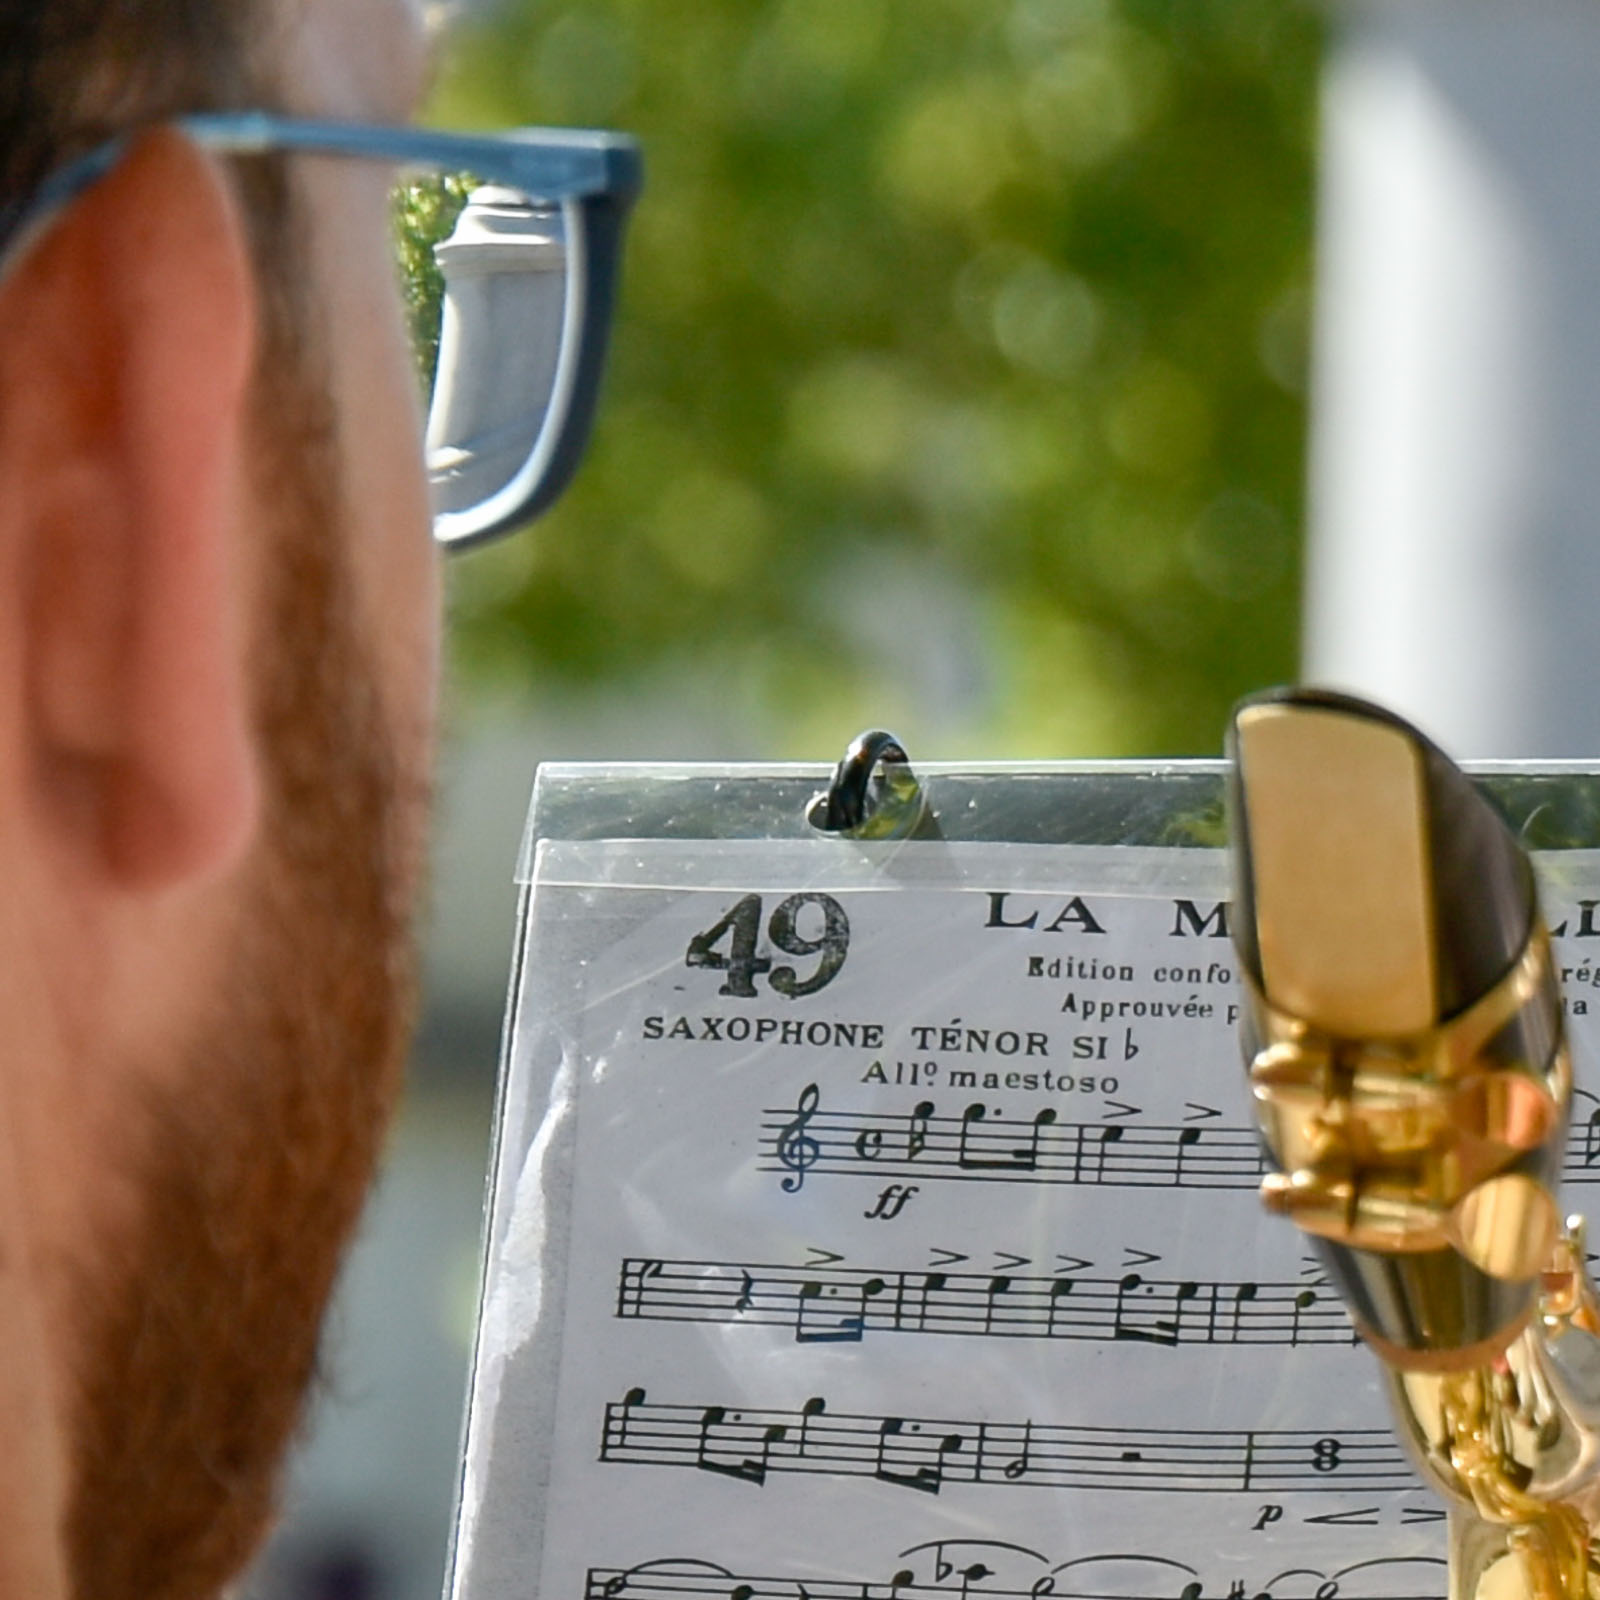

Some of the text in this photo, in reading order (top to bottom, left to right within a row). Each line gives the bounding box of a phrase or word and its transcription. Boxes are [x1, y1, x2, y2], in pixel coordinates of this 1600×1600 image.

[984, 892, 1107, 935] LA
[686, 891, 849, 999] 49
[1027, 956, 1134, 982] Edition
[1153, 963, 1232, 985] confo
[1061, 993, 1213, 1023] Approuvée
[643, 1016, 885, 1050] SAXOPHONE
[911, 1018, 1050, 1057] TÉNOR
[949, 1069, 1119, 1094] maestoso
